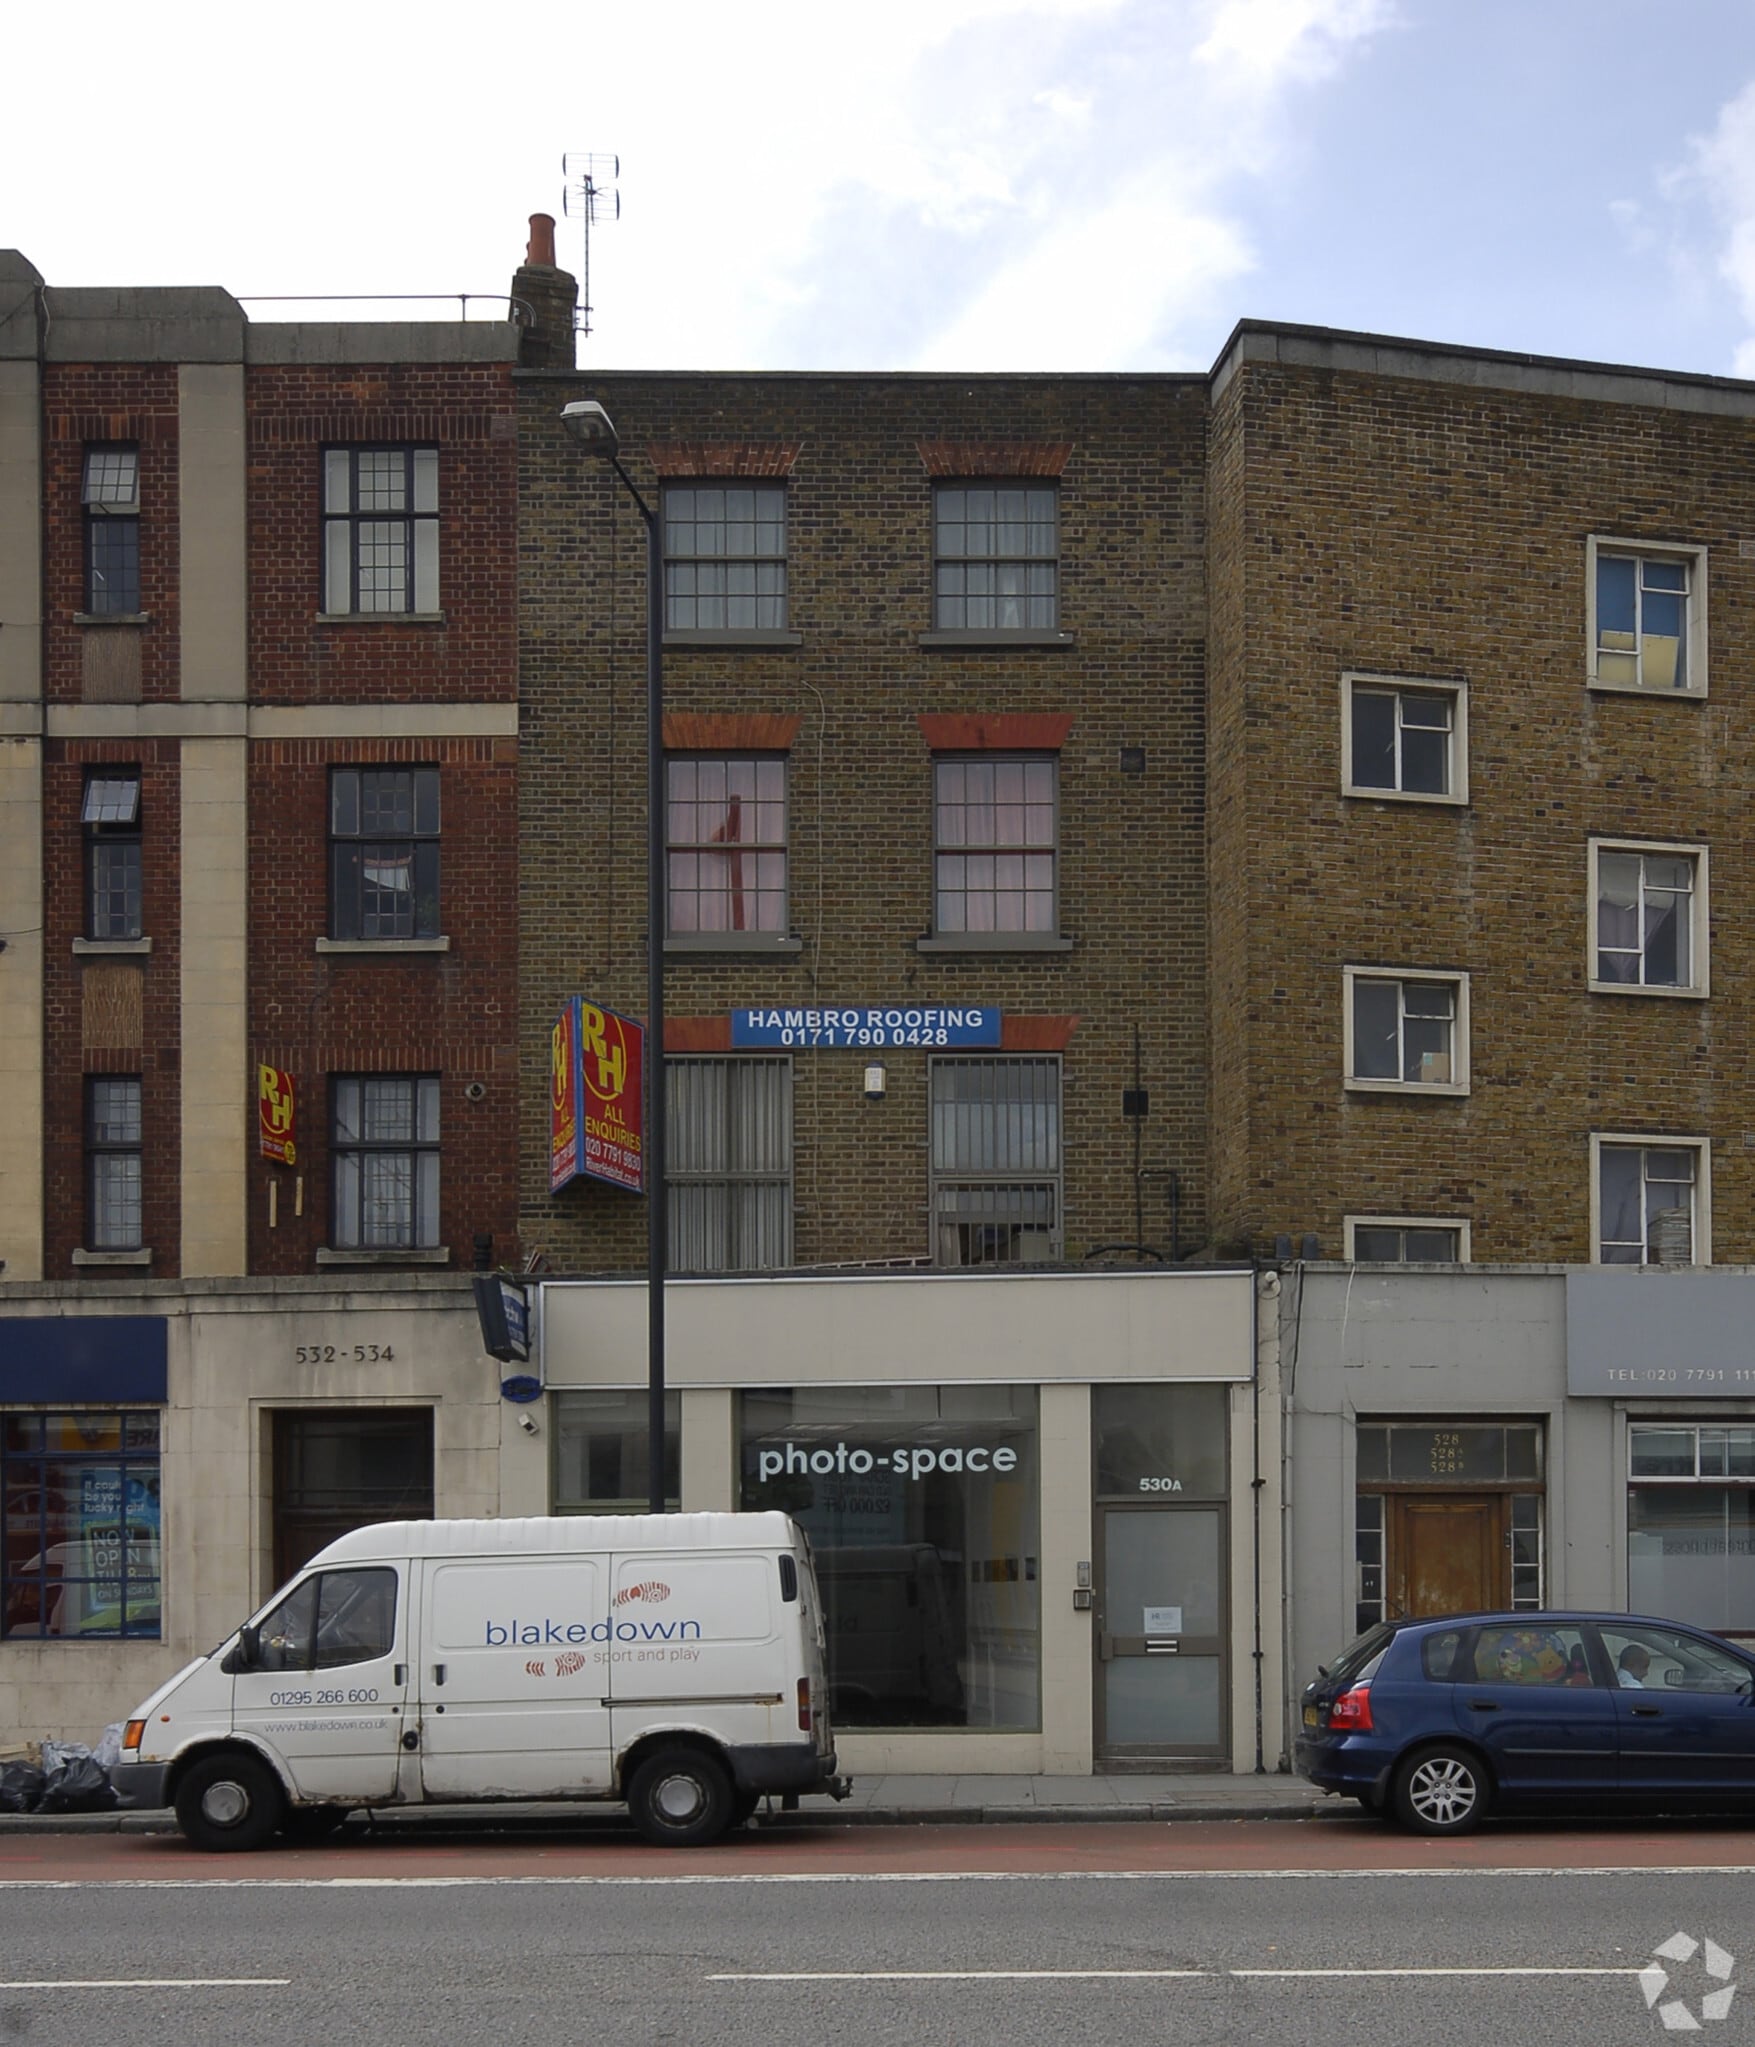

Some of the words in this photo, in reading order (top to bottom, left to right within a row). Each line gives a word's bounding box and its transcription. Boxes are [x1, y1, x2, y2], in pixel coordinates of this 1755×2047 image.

[748, 1010, 860, 1028] HAMBRO
[867, 1010, 983, 1027] ROOFING
[781, 1028, 835, 1046] 0171
[844, 1028, 885, 1045] 790
[892, 1028, 949, 1045] 0428
[582, 1002, 624, 1094] RH
[260, 1064, 292, 1130] RH
[604, 1103, 626, 1126] ALL
[585, 1116, 641, 1151] ENQUIRIES
[585, 1136, 602, 1157] 020
[602, 1142, 623, 1165] 7791
[1686, 1368, 1725, 1381] 7791
[1433, 1433, 1459, 1447] 528
[760, 1442, 1017, 1482] photo-space
[95, 1480, 122, 1490] coul
[1139, 1477, 1183, 1492] 530A
[84, 1492, 99, 1502] be
[84, 1503, 114, 1515] lucky
[94, 1547, 141, 1569] OPN
[113, 1585, 153, 1597] SNDAYS
[486, 1616, 701, 1646] blakedown
[593, 1650, 633, 1664] sport
[638, 1648, 665, 1662] and
[670, 1646, 700, 1663] play
[270, 1690, 312, 1706] 01295
[316, 1689, 344, 1704] 266
[348, 1688, 379, 1703] 600
[264, 1718, 389, 1733] www.blakedown.co.uk
